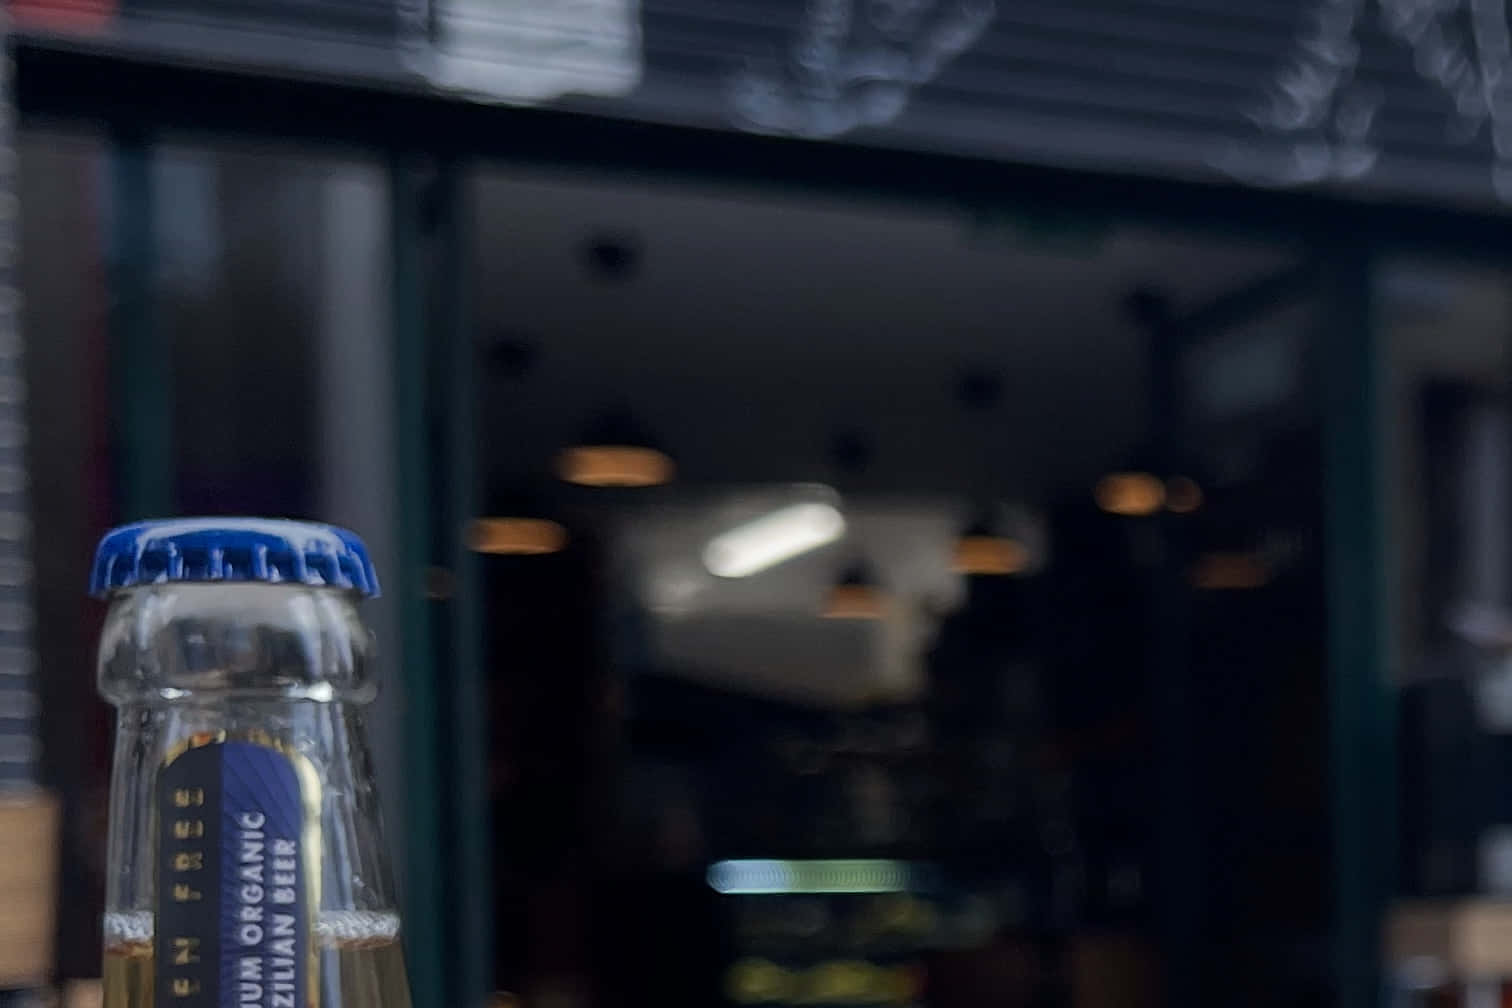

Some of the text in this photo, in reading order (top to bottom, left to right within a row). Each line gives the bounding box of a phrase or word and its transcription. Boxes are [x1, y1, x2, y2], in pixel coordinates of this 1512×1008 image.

[174, 788, 204, 900] FREE
[240, 811, 265, 946] ORGANIC
[273, 838, 296, 904] BEER
